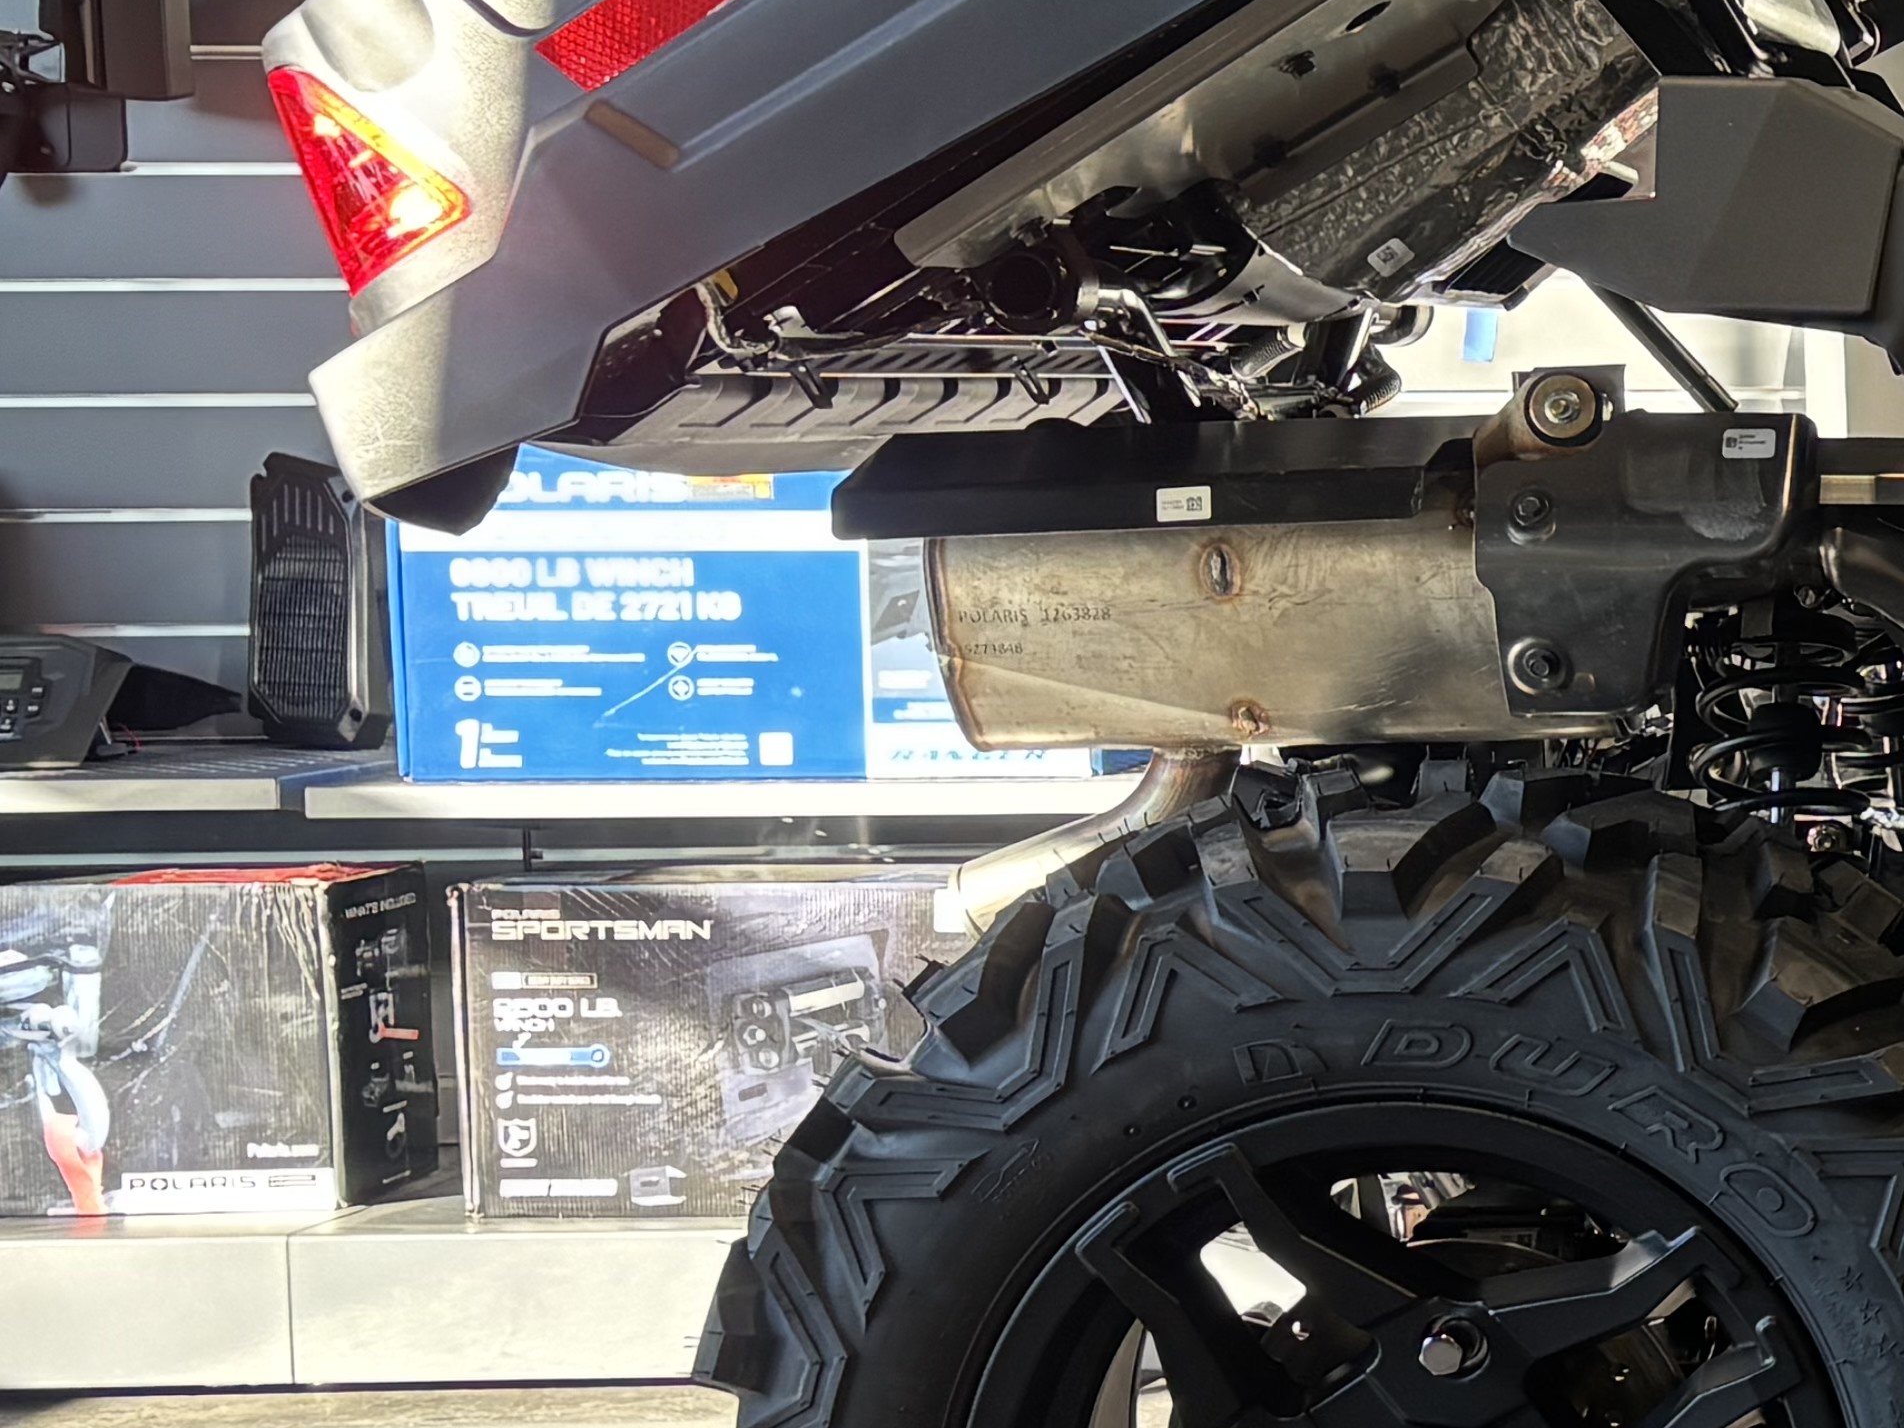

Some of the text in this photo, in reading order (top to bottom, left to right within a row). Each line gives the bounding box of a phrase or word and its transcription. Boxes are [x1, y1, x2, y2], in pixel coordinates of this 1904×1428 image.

[498, 471, 690, 503] OLARIS
[958, 607, 1029, 623] POLARIS
[491, 909, 560, 920] POLARIS
[491, 919, 712, 941] SPORTSMAN
[1360, 1017, 1819, 1239] DURO
[129, 1177, 257, 1191] POLARIS
